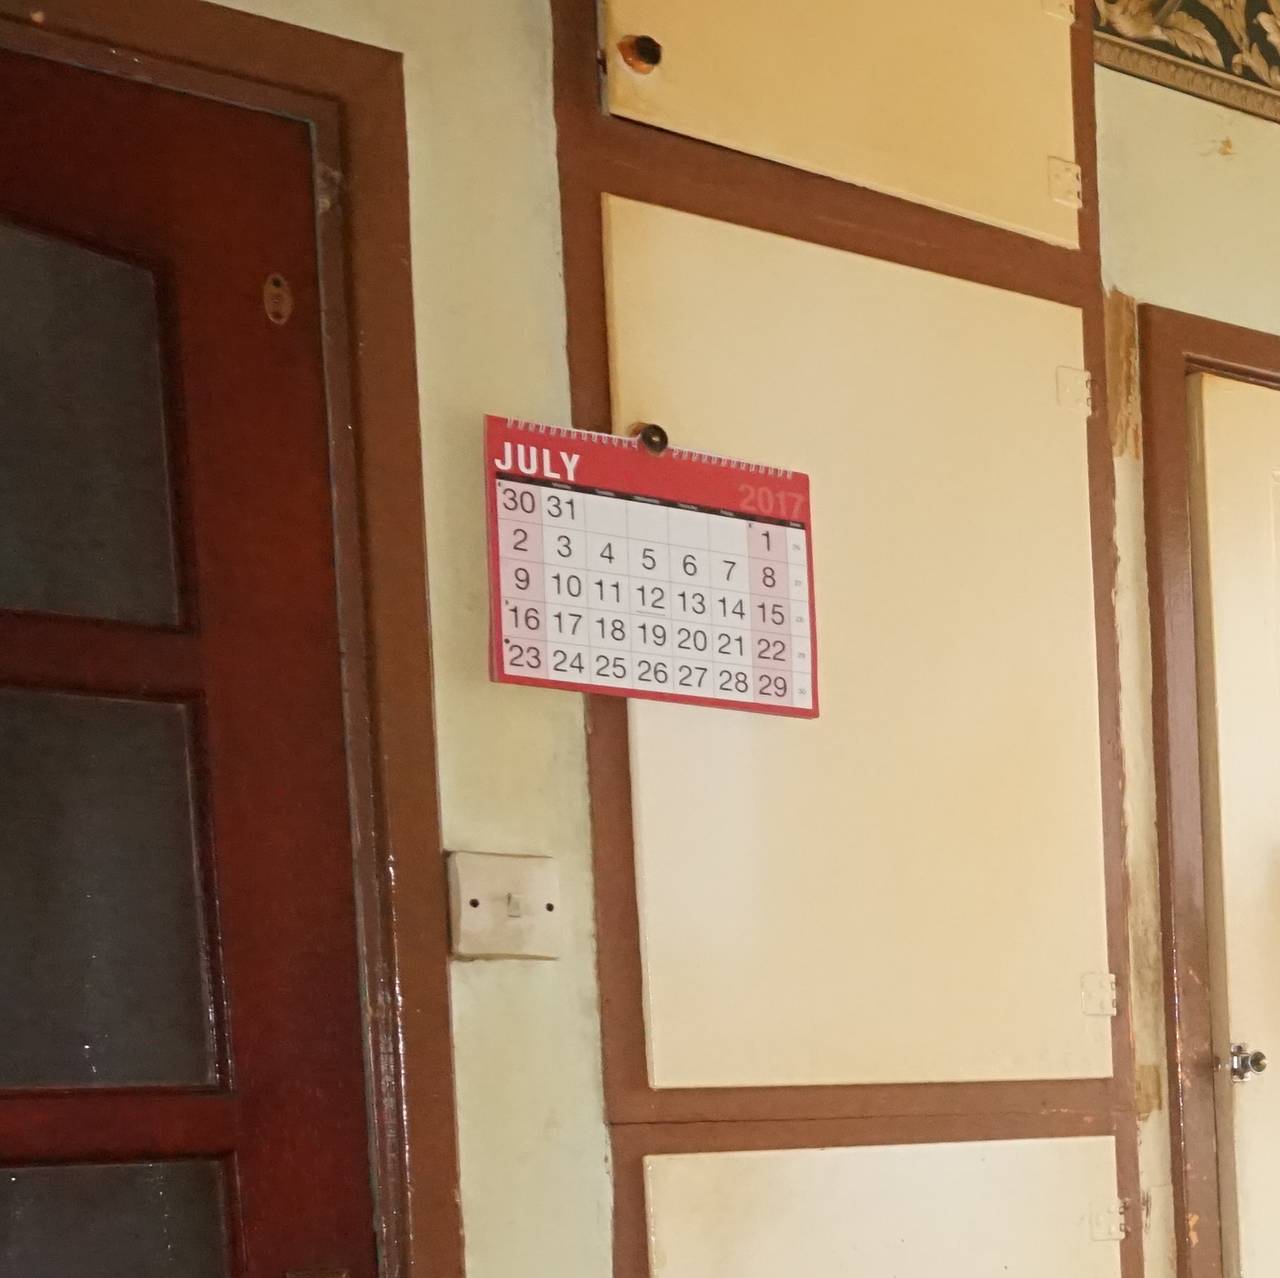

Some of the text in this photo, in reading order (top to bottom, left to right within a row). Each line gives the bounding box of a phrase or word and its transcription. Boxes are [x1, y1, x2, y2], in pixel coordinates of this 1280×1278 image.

[494, 441, 804, 517] JULY 2017
[501, 487, 771, 552] 30 31 1
[512, 528, 777, 589] 2 3 4 5 6 7 8
[513, 567, 785, 626] 9 10 11 12 13 14 15
[508, 605, 787, 663] 16 17 18 19 20 21 22
[508, 643, 788, 698] 23 24 25 26 27 28 29
